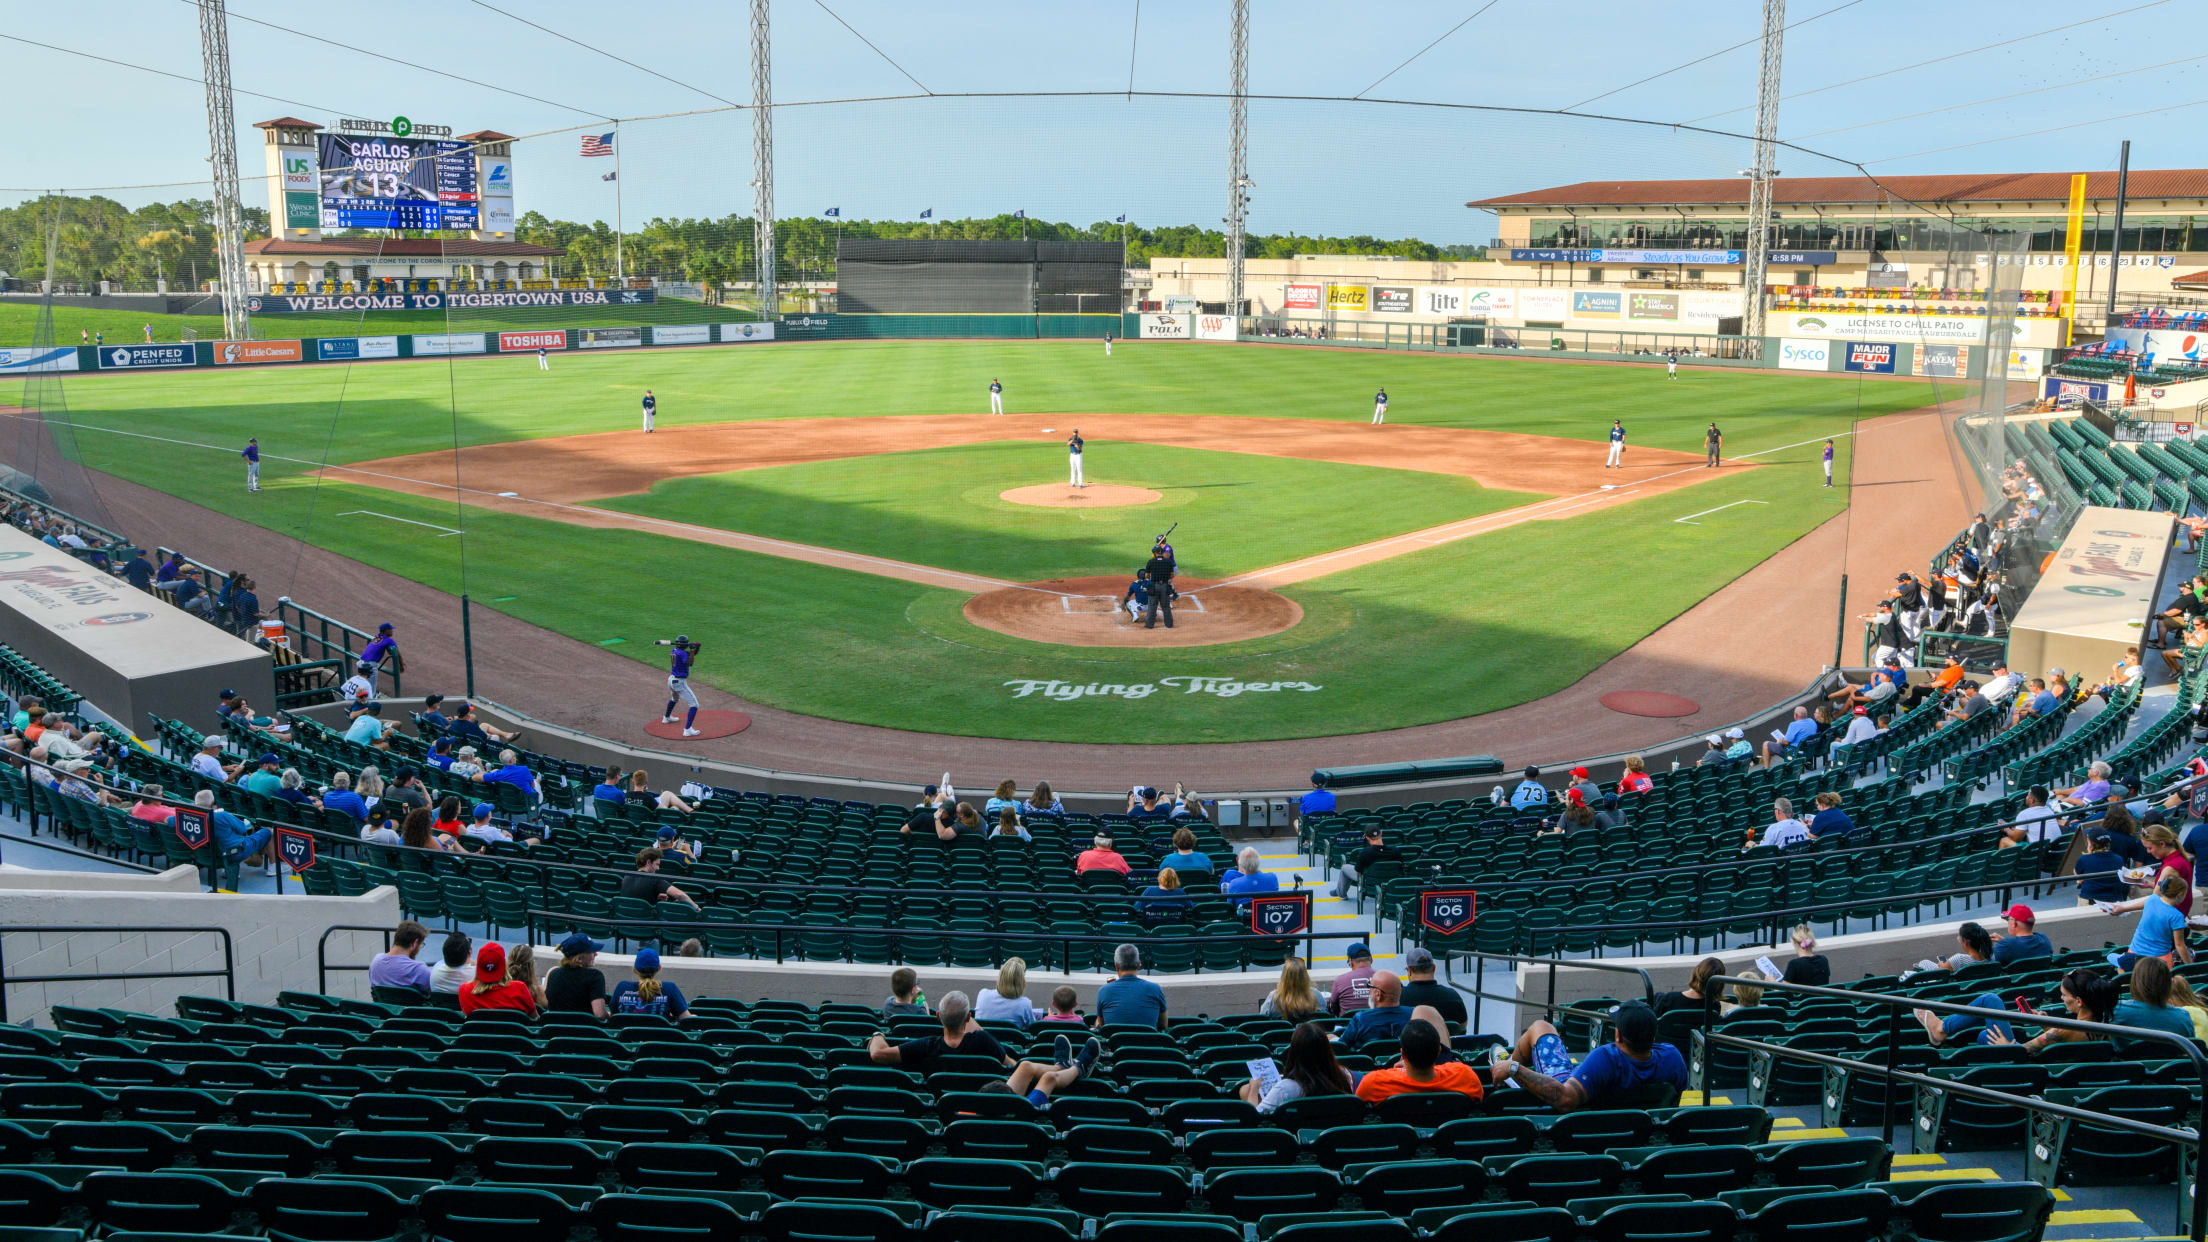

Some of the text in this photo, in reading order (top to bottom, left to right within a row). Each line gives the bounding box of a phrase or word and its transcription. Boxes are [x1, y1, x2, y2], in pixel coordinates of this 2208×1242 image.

[350, 142, 411, 159] CARLOS
[286, 158, 309, 174] US
[353, 158, 410, 173] AGUIAR
[287, 175, 311, 183] FOODS
[368, 172, 399, 198] 13
[289, 203, 315, 211] WATSON
[1642, 252, 1671, 263] Steady
[1684, 253, 1700, 262] You
[1702, 253, 1726, 262] Grow
[1772, 252, 1804, 262] 6:58 PM
[286, 291, 609, 311] WELCOME TO TIGERTOWN USA
[1329, 290, 1366, 304] Hertz
[1430, 292, 1459, 313] Lite
[1591, 297, 1617, 306] AGNINI
[1148, 325, 1182, 333] POLK
[1848, 319, 1965, 330] LICENSE TO CHILL PATIO
[503, 335, 562, 347] TOSHIBA
[133, 349, 183, 359] PENFED
[245, 347, 295, 357] Little Caesars
[1784, 344, 1825, 362] Sysco
[1853, 343, 1890, 354] MAJOR
[1853, 354, 1889, 363] FUN
[1923, 355, 1956, 367] KAYEM
[1003, 675, 1323, 701] Flying Tigers
[1522, 786, 1543, 801] 73
[2194, 791, 2207, 804] 106
[183, 814, 200, 822] SECTION
[182, 820, 201, 834] 108
[286, 835, 305, 844] SECTION
[286, 842, 305, 856] 107
[1435, 896, 1463, 904] SECTION
[1433, 904, 1463, 917] 106
[1265, 911, 1294, 924] 107
